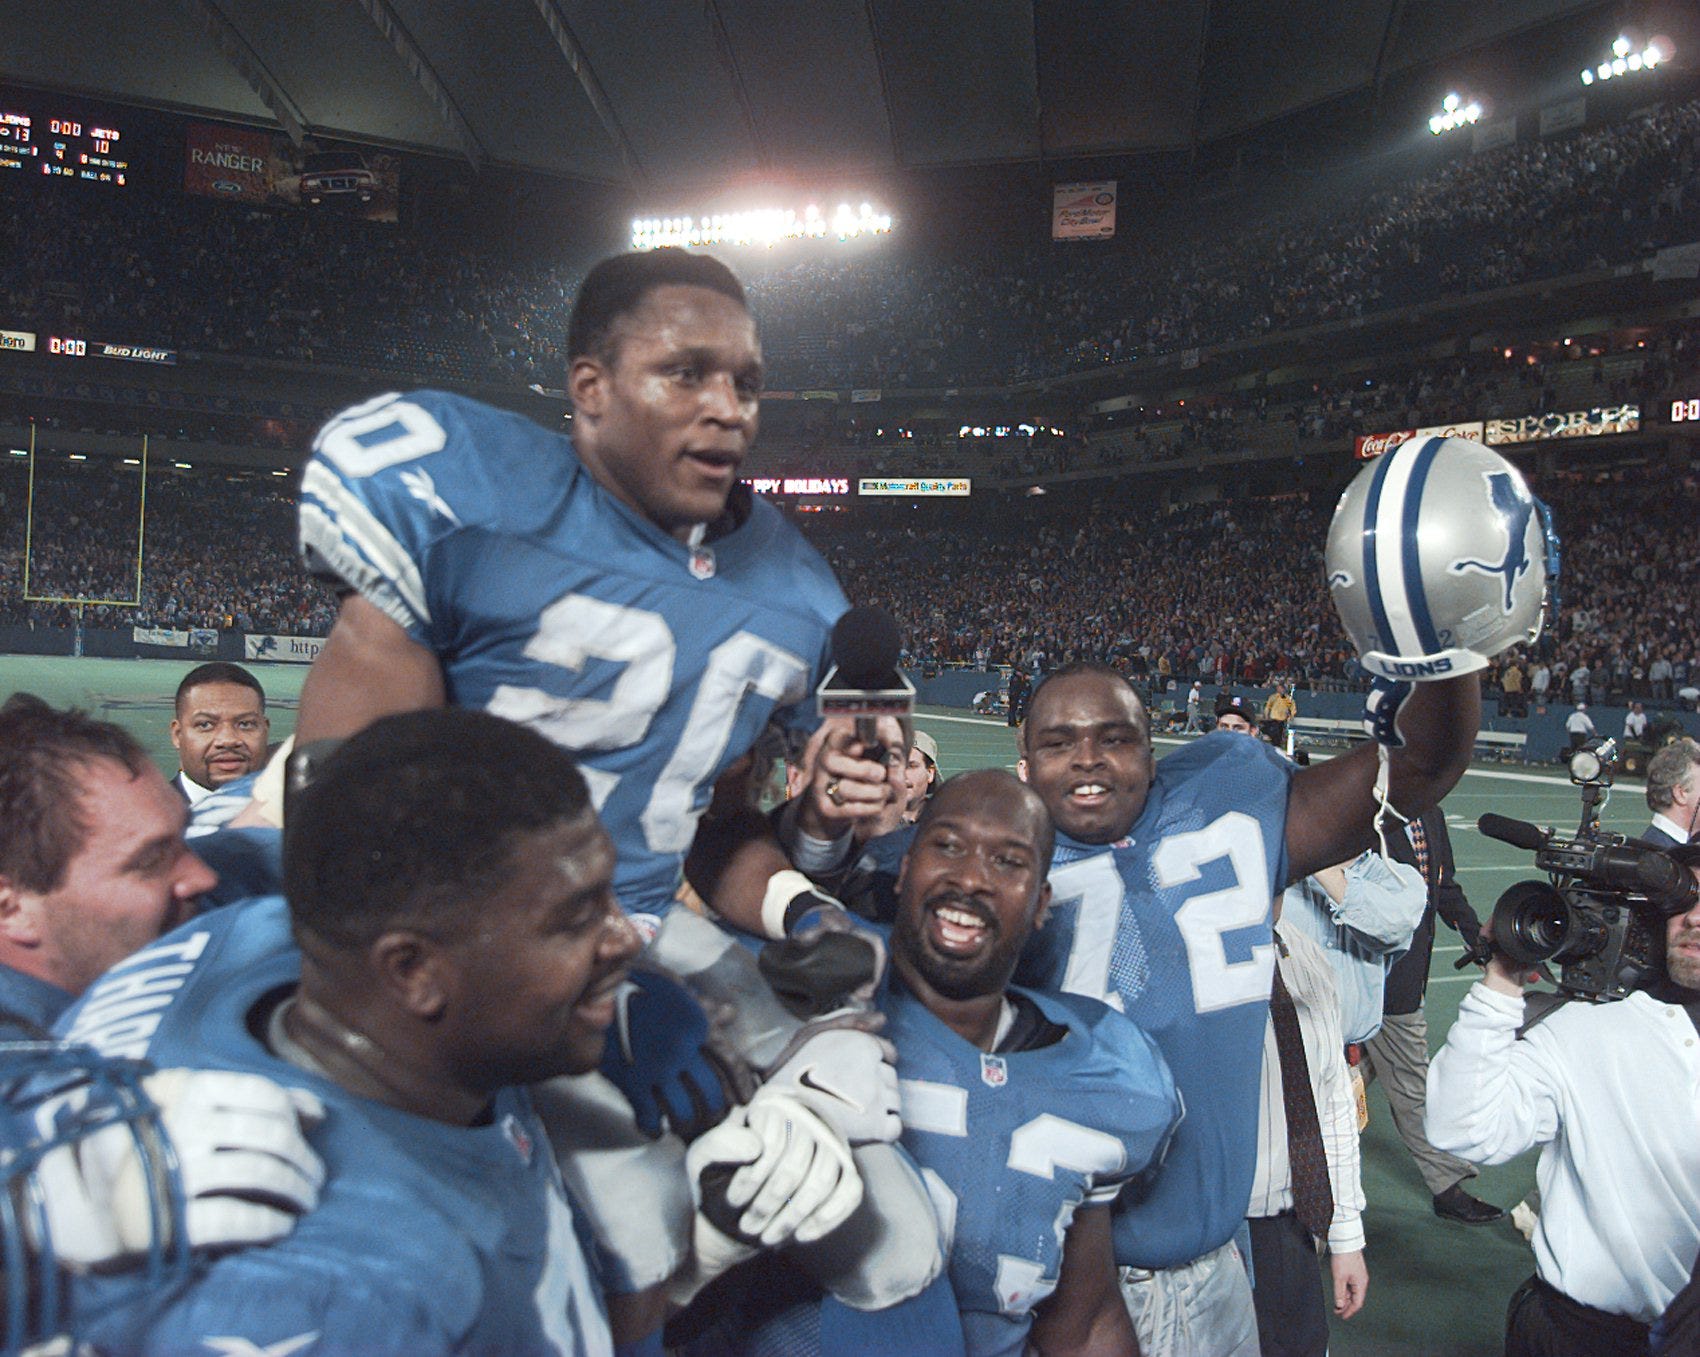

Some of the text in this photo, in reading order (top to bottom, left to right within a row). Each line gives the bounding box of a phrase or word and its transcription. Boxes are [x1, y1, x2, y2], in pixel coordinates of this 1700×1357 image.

[95, 140, 110, 153] 10
[192, 147, 265, 173] RANGER
[103, 345, 168, 361] BUD LIGHT
[290, 639, 319, 659] http
[1380, 658, 1452, 677] LIONS
[1050, 811, 1276, 1014] 72
